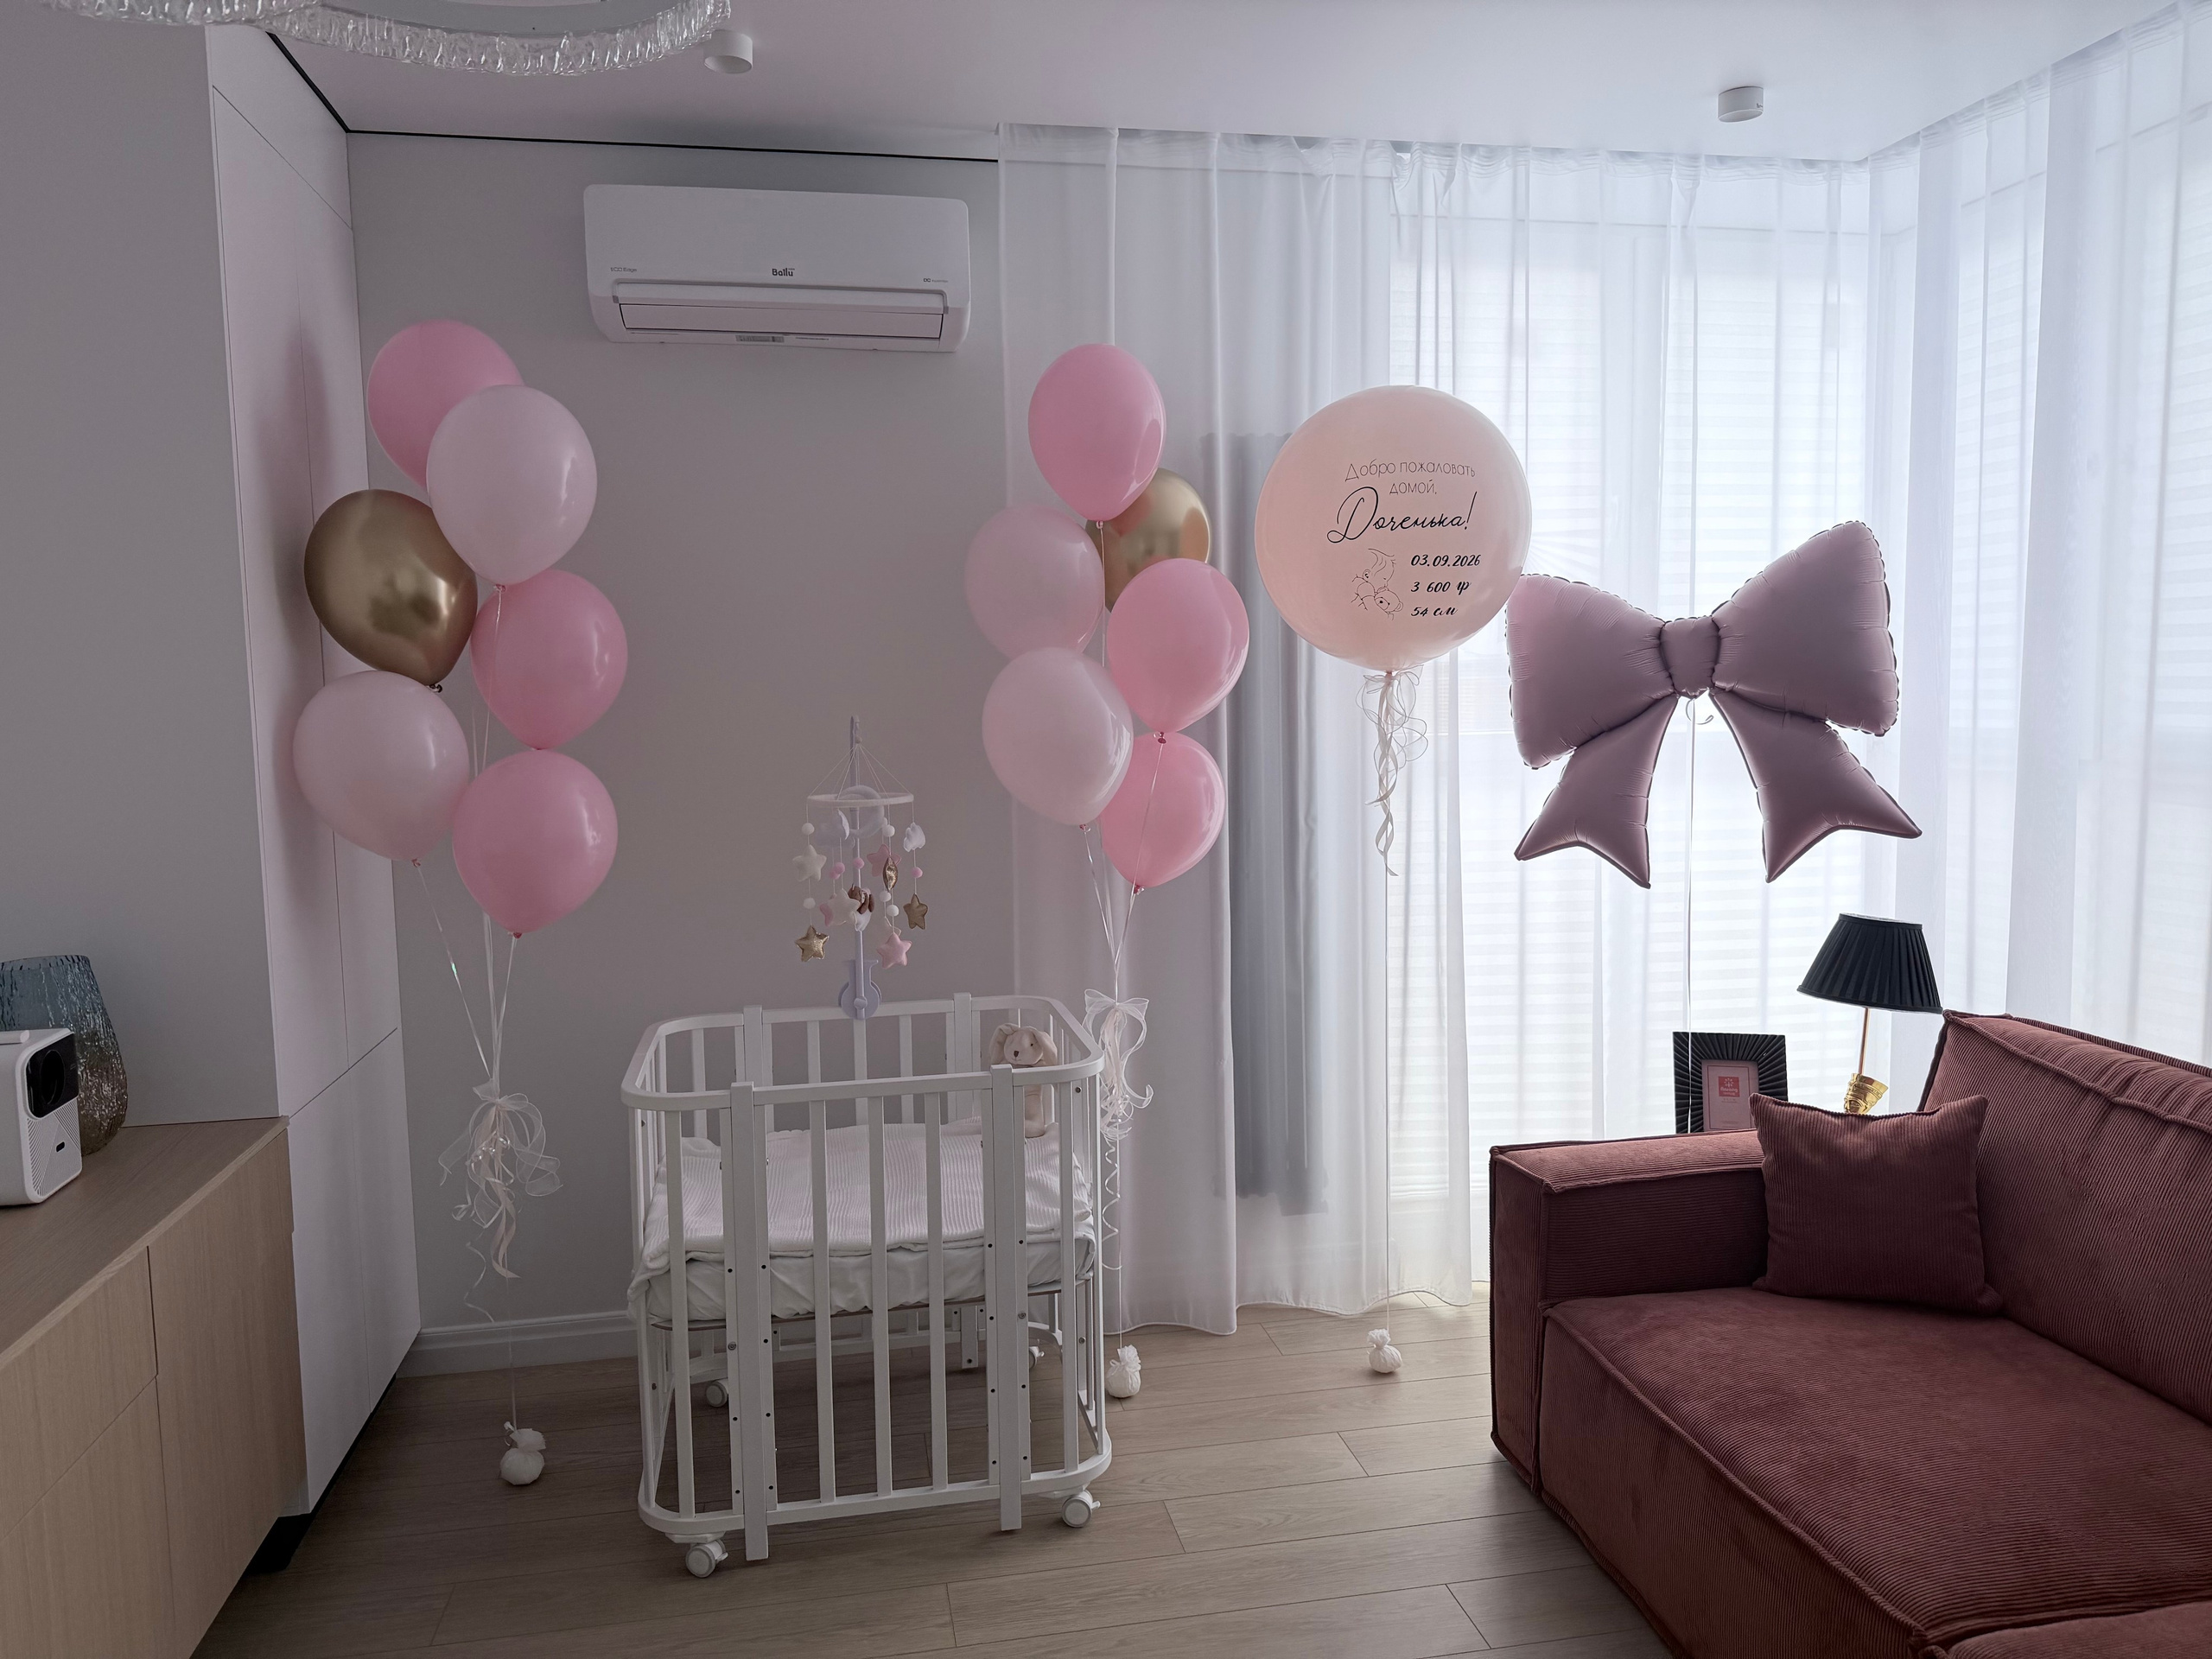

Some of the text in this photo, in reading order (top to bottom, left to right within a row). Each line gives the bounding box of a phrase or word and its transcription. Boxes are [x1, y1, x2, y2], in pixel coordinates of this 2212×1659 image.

[772, 267, 793, 276] Ballu
[1344, 458, 1476, 482] Добро пожаловать
[1326, 486, 1478, 543] Доченька!
[1410, 554, 1481, 567] 03.09.2026
[1410, 581, 1471, 595] 3 600 гр
[1410, 607, 1459, 617] 54 см
